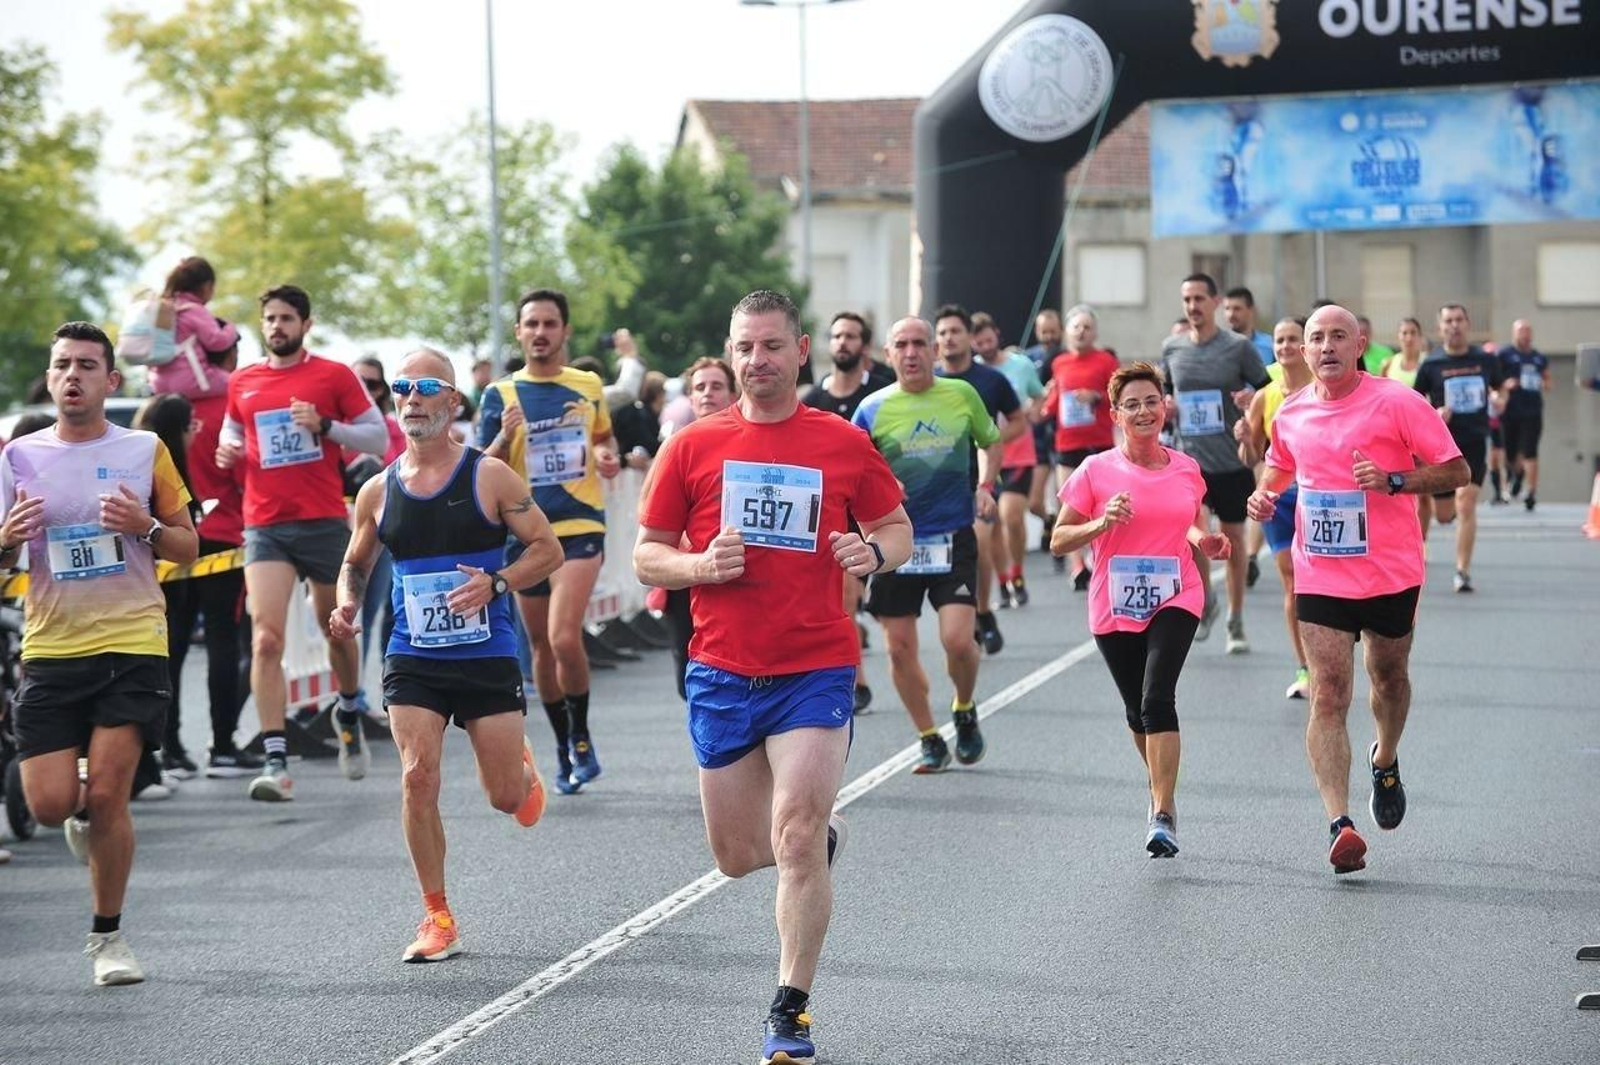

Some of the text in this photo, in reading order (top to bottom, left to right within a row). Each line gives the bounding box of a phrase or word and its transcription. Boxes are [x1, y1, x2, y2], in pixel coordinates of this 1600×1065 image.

[1318, 0, 1582, 38] OURENSE
[1400, 44, 1501, 68] Deportes
[270, 432, 303, 455] 542
[544, 453, 566, 473] 66
[743, 498, 794, 531] 597
[1312, 519, 1345, 544] 267
[1124, 585, 1161, 610] 235
[423, 606, 467, 633] 236
